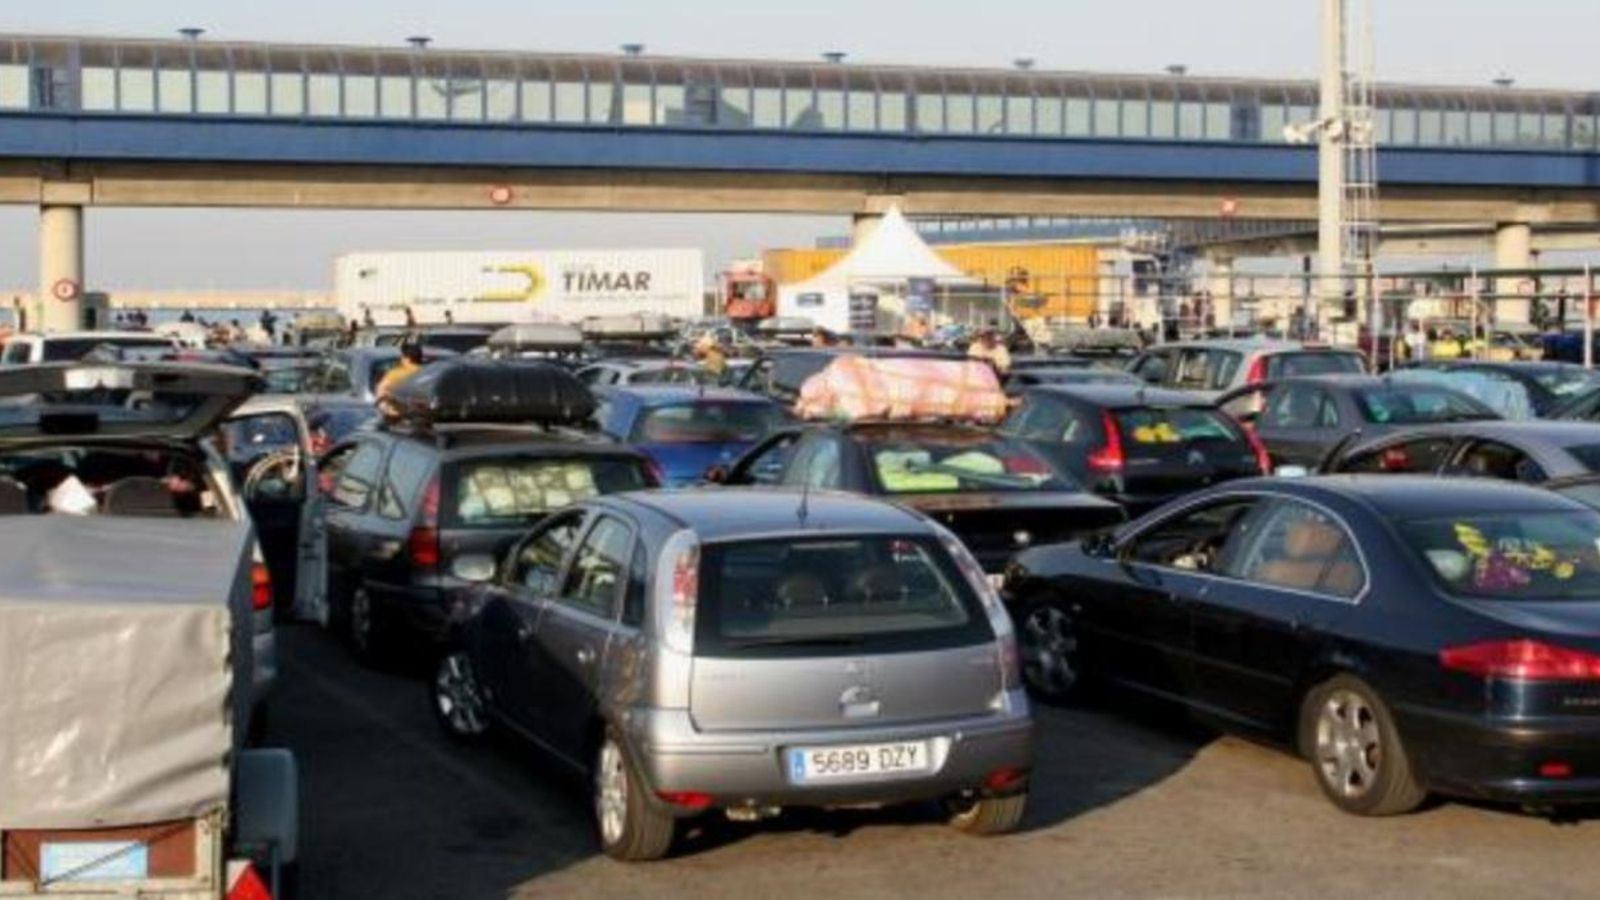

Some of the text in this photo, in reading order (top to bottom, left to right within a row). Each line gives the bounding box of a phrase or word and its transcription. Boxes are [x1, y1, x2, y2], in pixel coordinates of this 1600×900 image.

[562, 270, 652, 292] TIMAR
[812, 749, 871, 774] 5689
[878, 745, 918, 770] DZY
